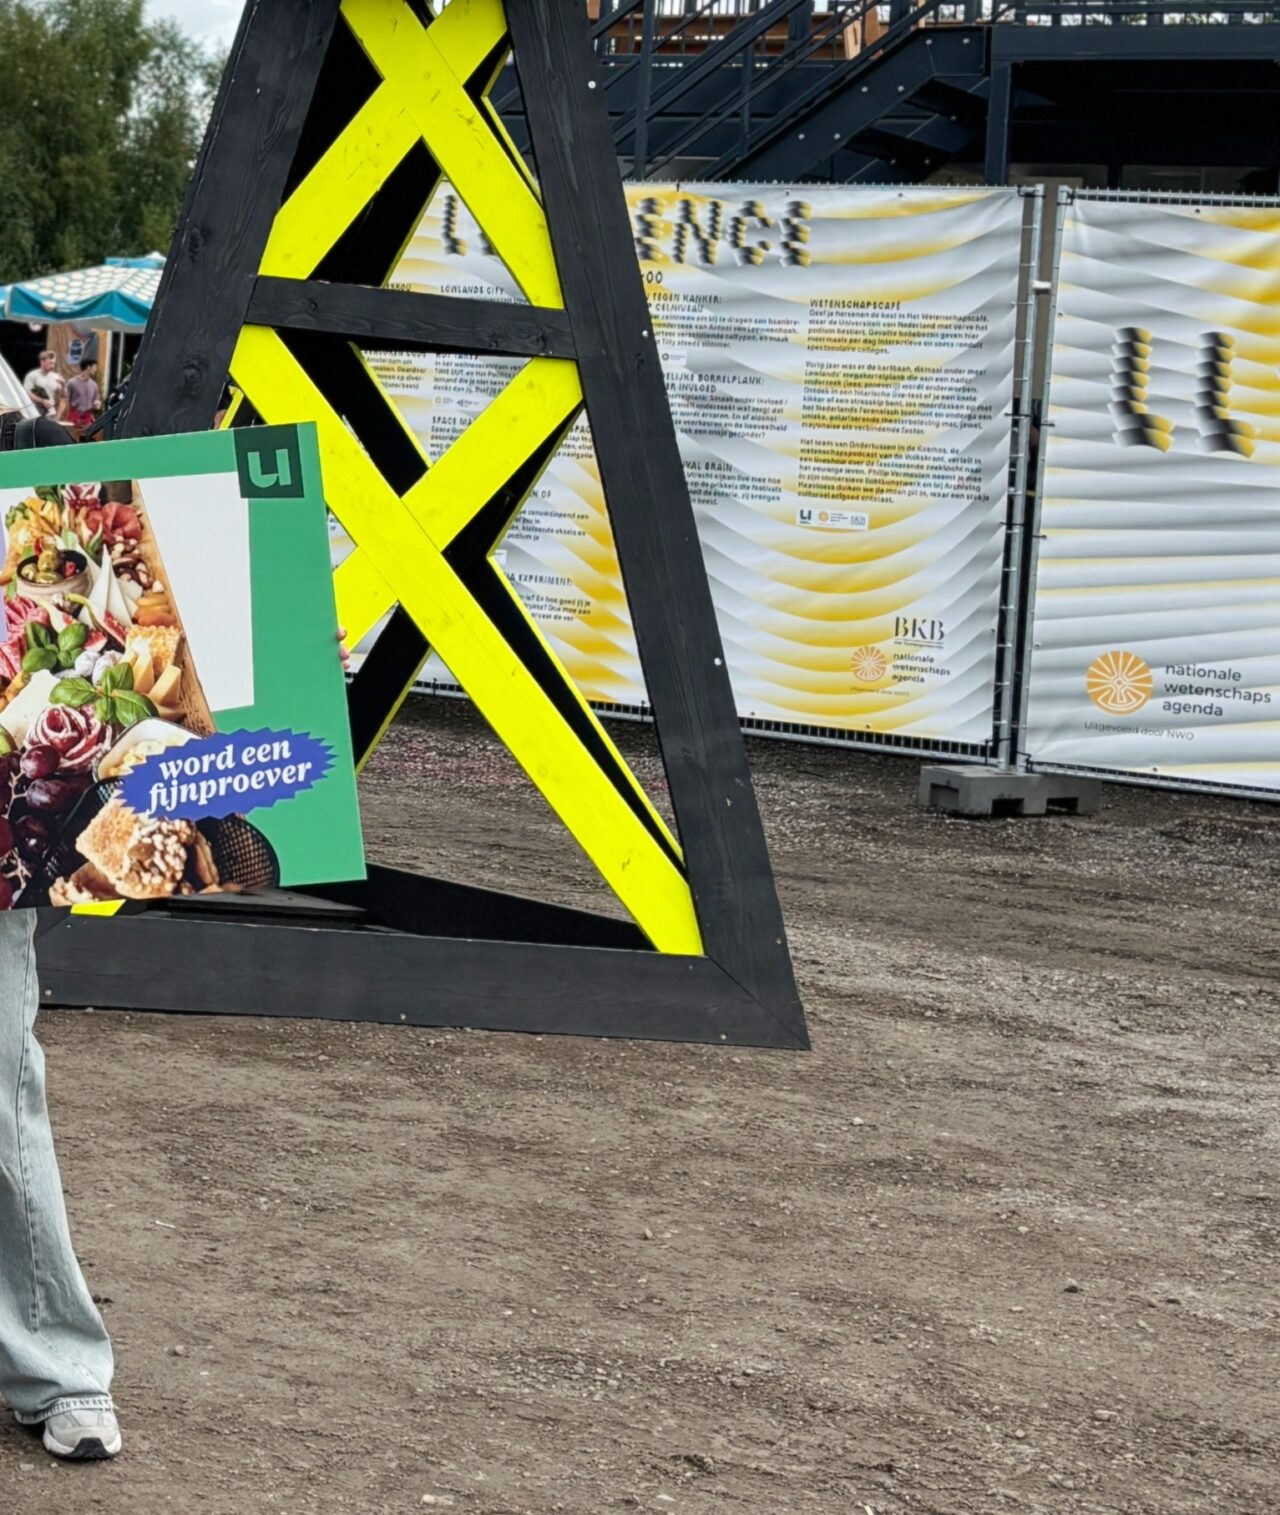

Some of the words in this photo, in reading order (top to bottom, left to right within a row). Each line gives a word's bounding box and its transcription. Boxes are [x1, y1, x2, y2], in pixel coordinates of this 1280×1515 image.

[636, 198, 813, 267] ENCE
[894, 616, 944, 641] BKB
[894, 653, 934, 664] nationale
[892, 663, 950, 676] wetenschaps
[892, 674, 925, 683] agenda
[1166, 663, 1242, 682] nationale
[1164, 682, 1272, 704] wetenschaps
[1162, 700, 1224, 717] agenda
[158, 744, 236, 781] word
[242, 740, 292, 765] een
[146, 761, 312, 815] fijnproever
